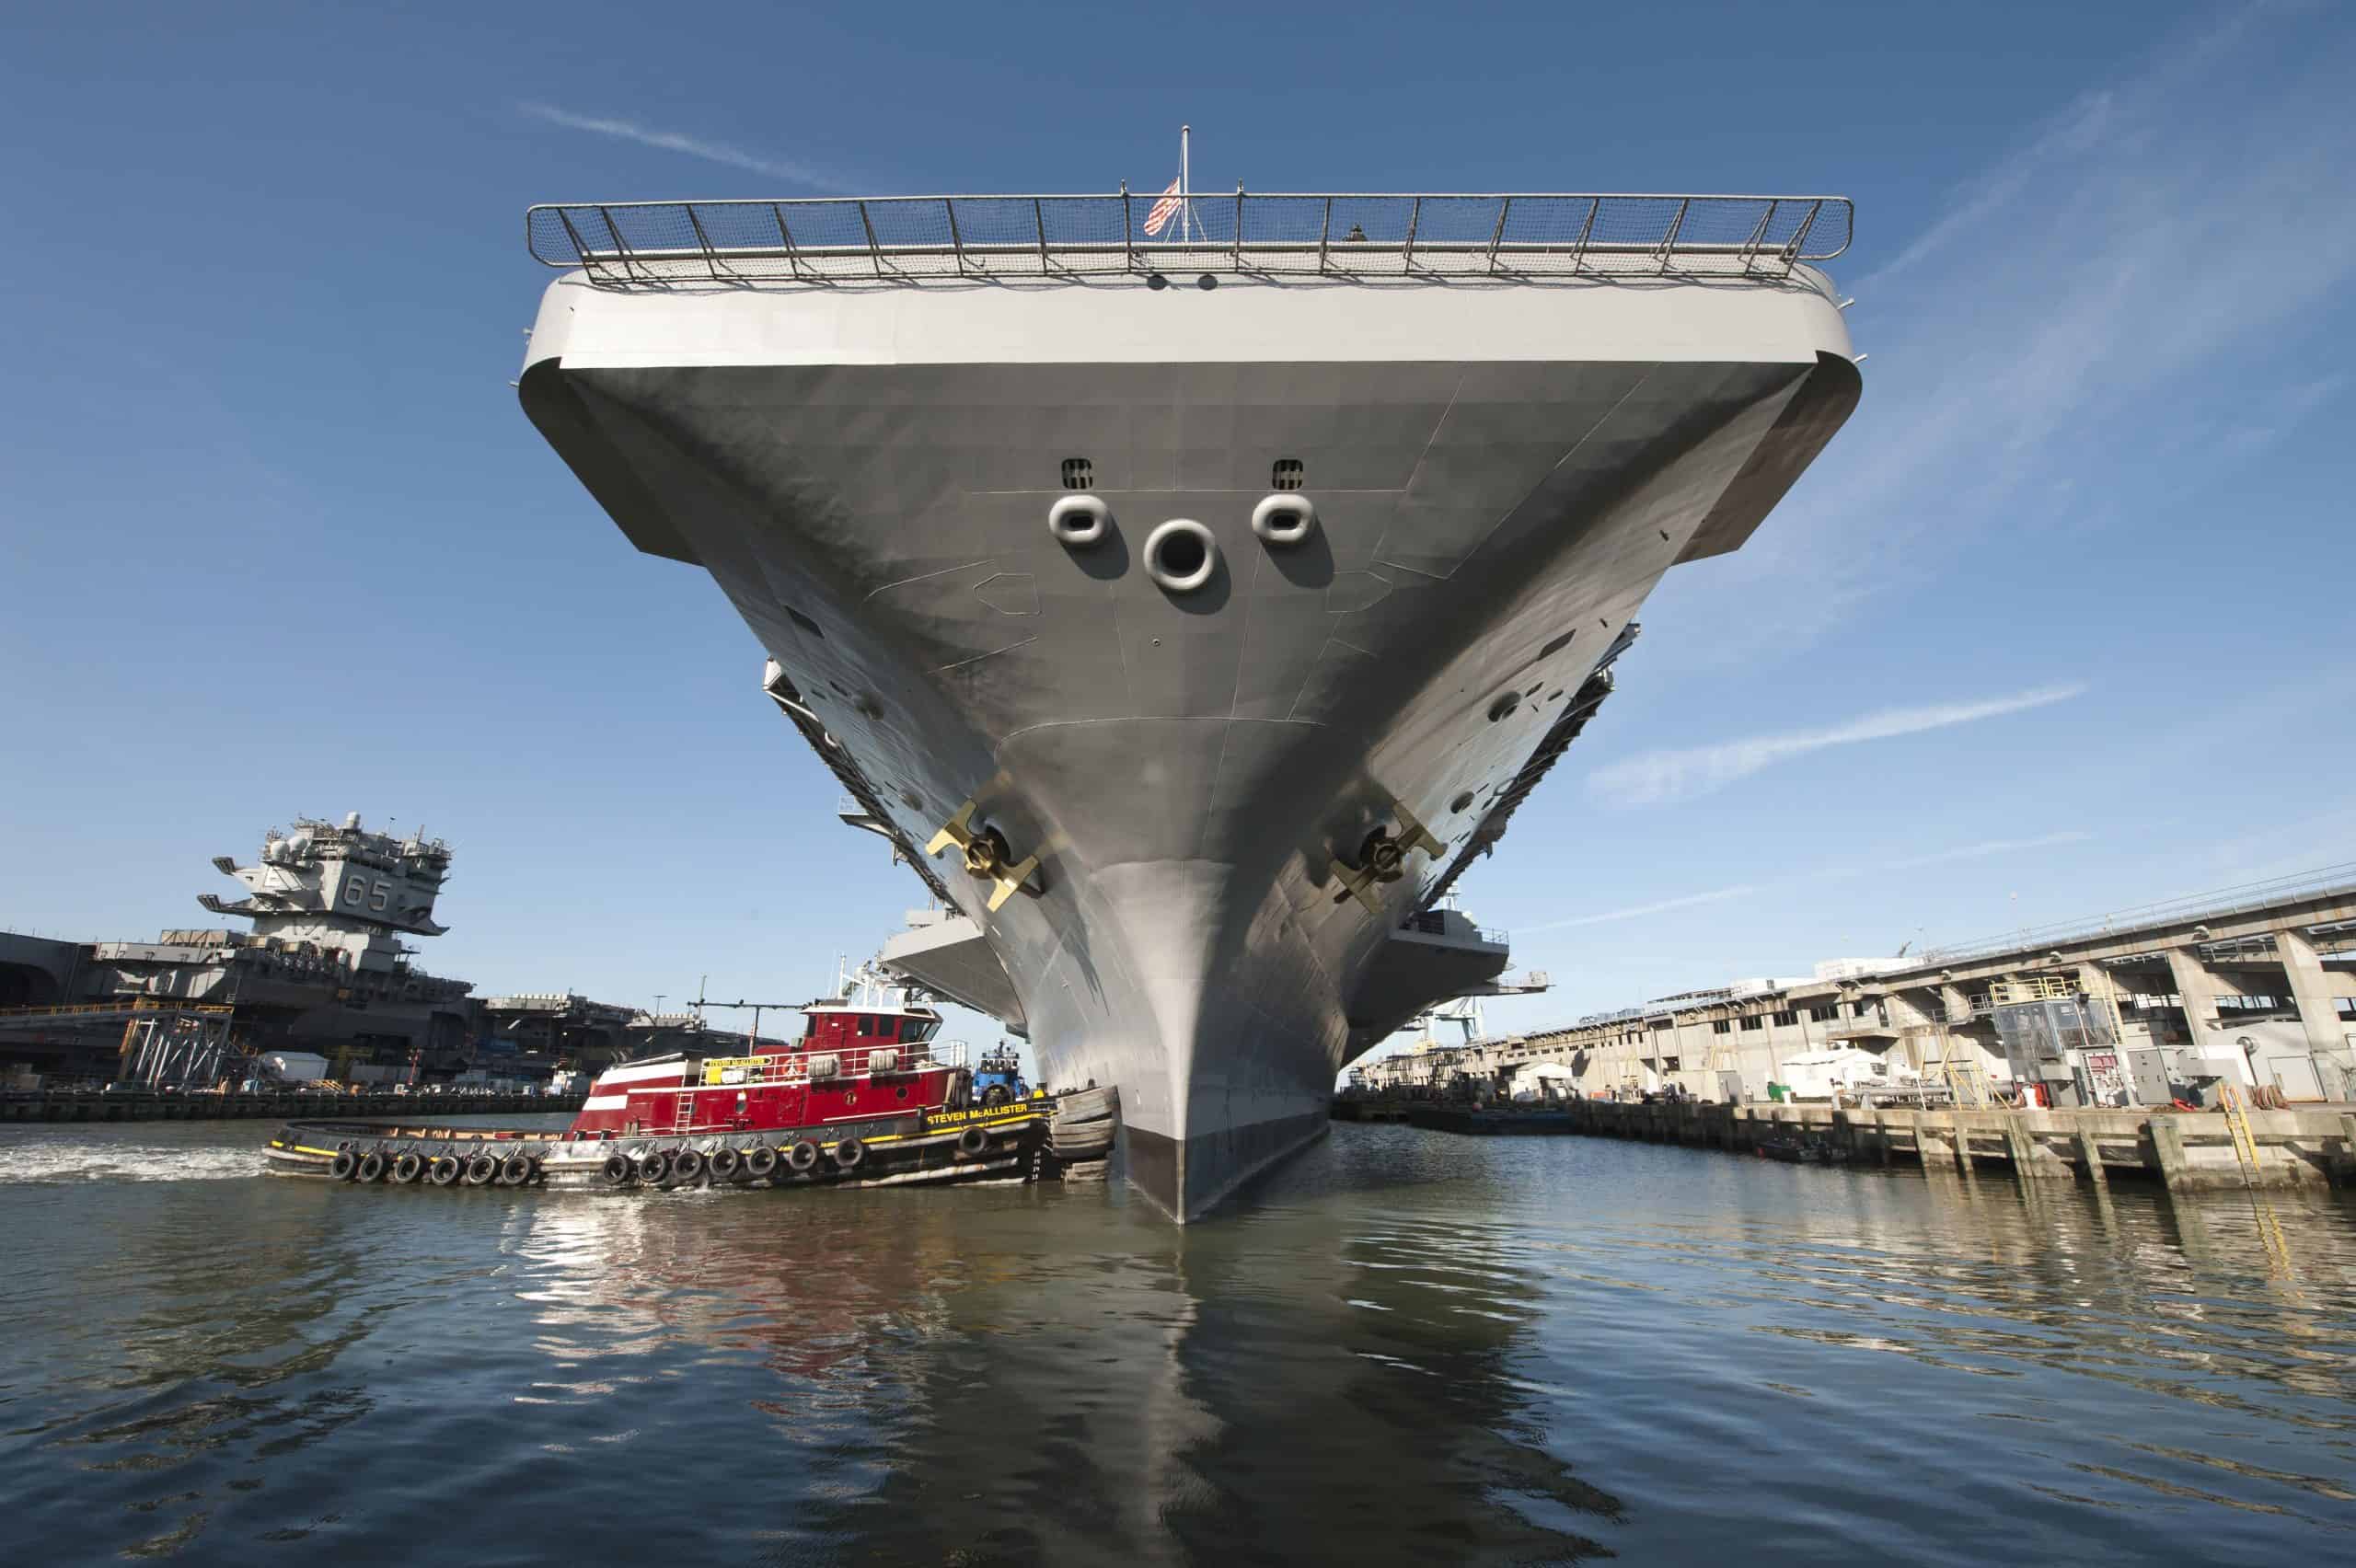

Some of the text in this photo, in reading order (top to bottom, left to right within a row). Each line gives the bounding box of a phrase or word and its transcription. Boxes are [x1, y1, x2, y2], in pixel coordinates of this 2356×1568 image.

[344, 874, 392, 912] 65
[927, 1103, 1028, 1125] STEVEN McALLISTER
